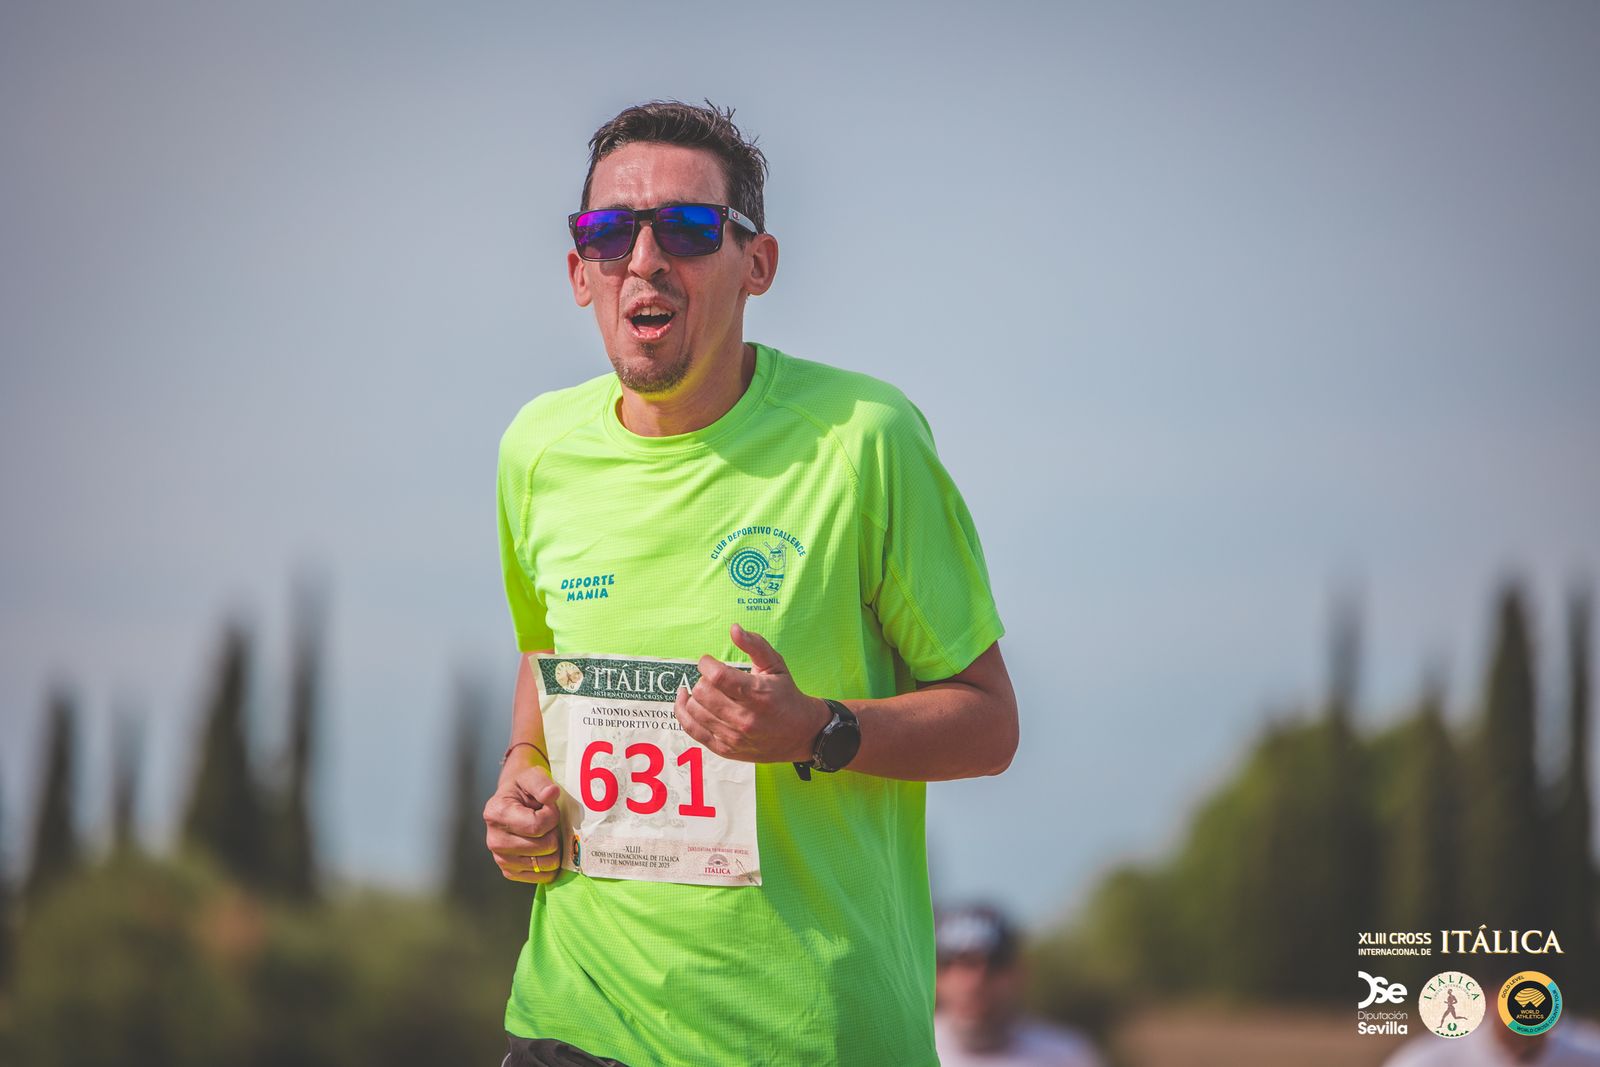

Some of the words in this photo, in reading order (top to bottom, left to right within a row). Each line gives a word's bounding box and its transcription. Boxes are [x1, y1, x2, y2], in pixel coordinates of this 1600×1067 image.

[710, 540, 727, 559] CLUB
[727, 526, 771, 542] DEPORTIVO
[773, 528, 806, 557] CALLENCE
[560, 574, 615, 590] DEPORTE
[566, 587, 609, 602] MANIA
[593, 663, 693, 695] ITÁLICA
[593, 691, 642, 699] INTERNATIONAL
[591, 707, 630, 717] ANTONIO
[632, 709, 668, 719] SANTOS
[670, 711, 677, 719] R
[583, 717, 604, 727] CLUB
[605, 719, 659, 729] DEPORTIVO
[580, 740, 716, 817] 631
[607, 852, 648, 861] INTERNACIONAL
